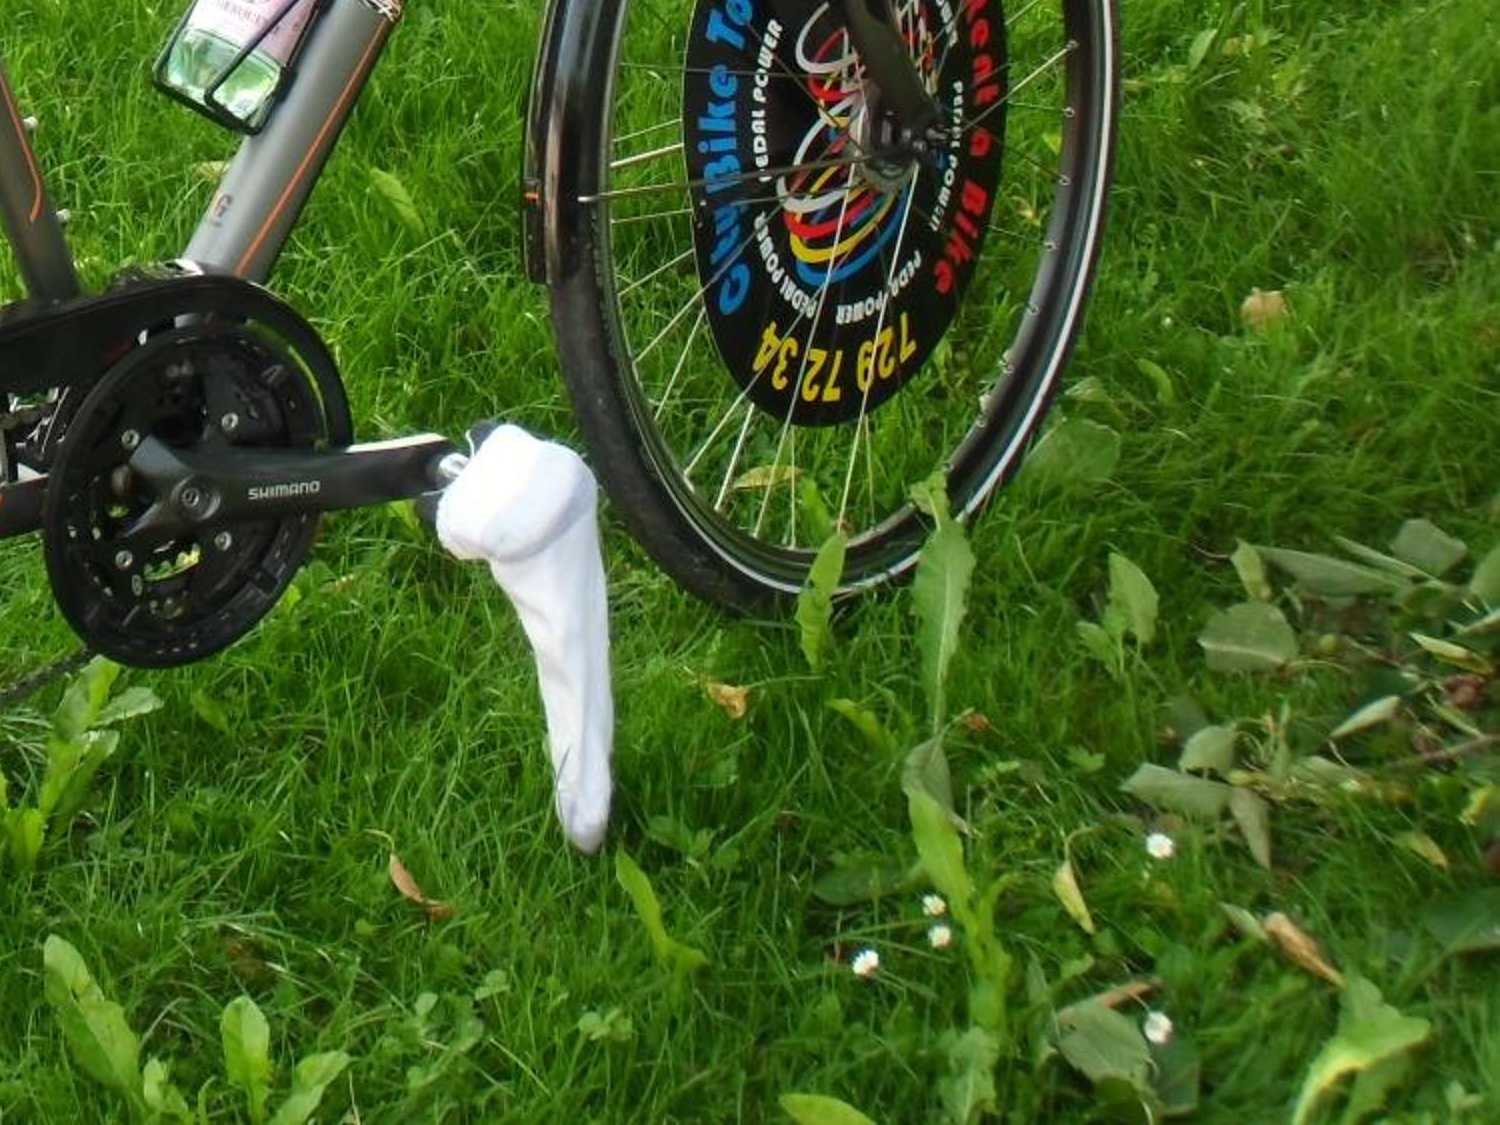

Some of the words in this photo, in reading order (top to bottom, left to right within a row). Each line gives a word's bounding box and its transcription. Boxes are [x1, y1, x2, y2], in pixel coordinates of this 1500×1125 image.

[753, 18, 783, 103] POWER
[697, 64, 741, 194] Bike
[754, 211, 785, 284] POWER
[935, 179, 988, 294] Bike
[780, 276, 818, 319] PEDAL
[836, 290, 887, 325] POWER
[887, 250, 922, 298] PEDA
[753, 321, 798, 390] 34
[801, 348, 843, 402] 72
[857, 312, 917, 393] 729
[248, 481, 321, 500] SHIMANO
